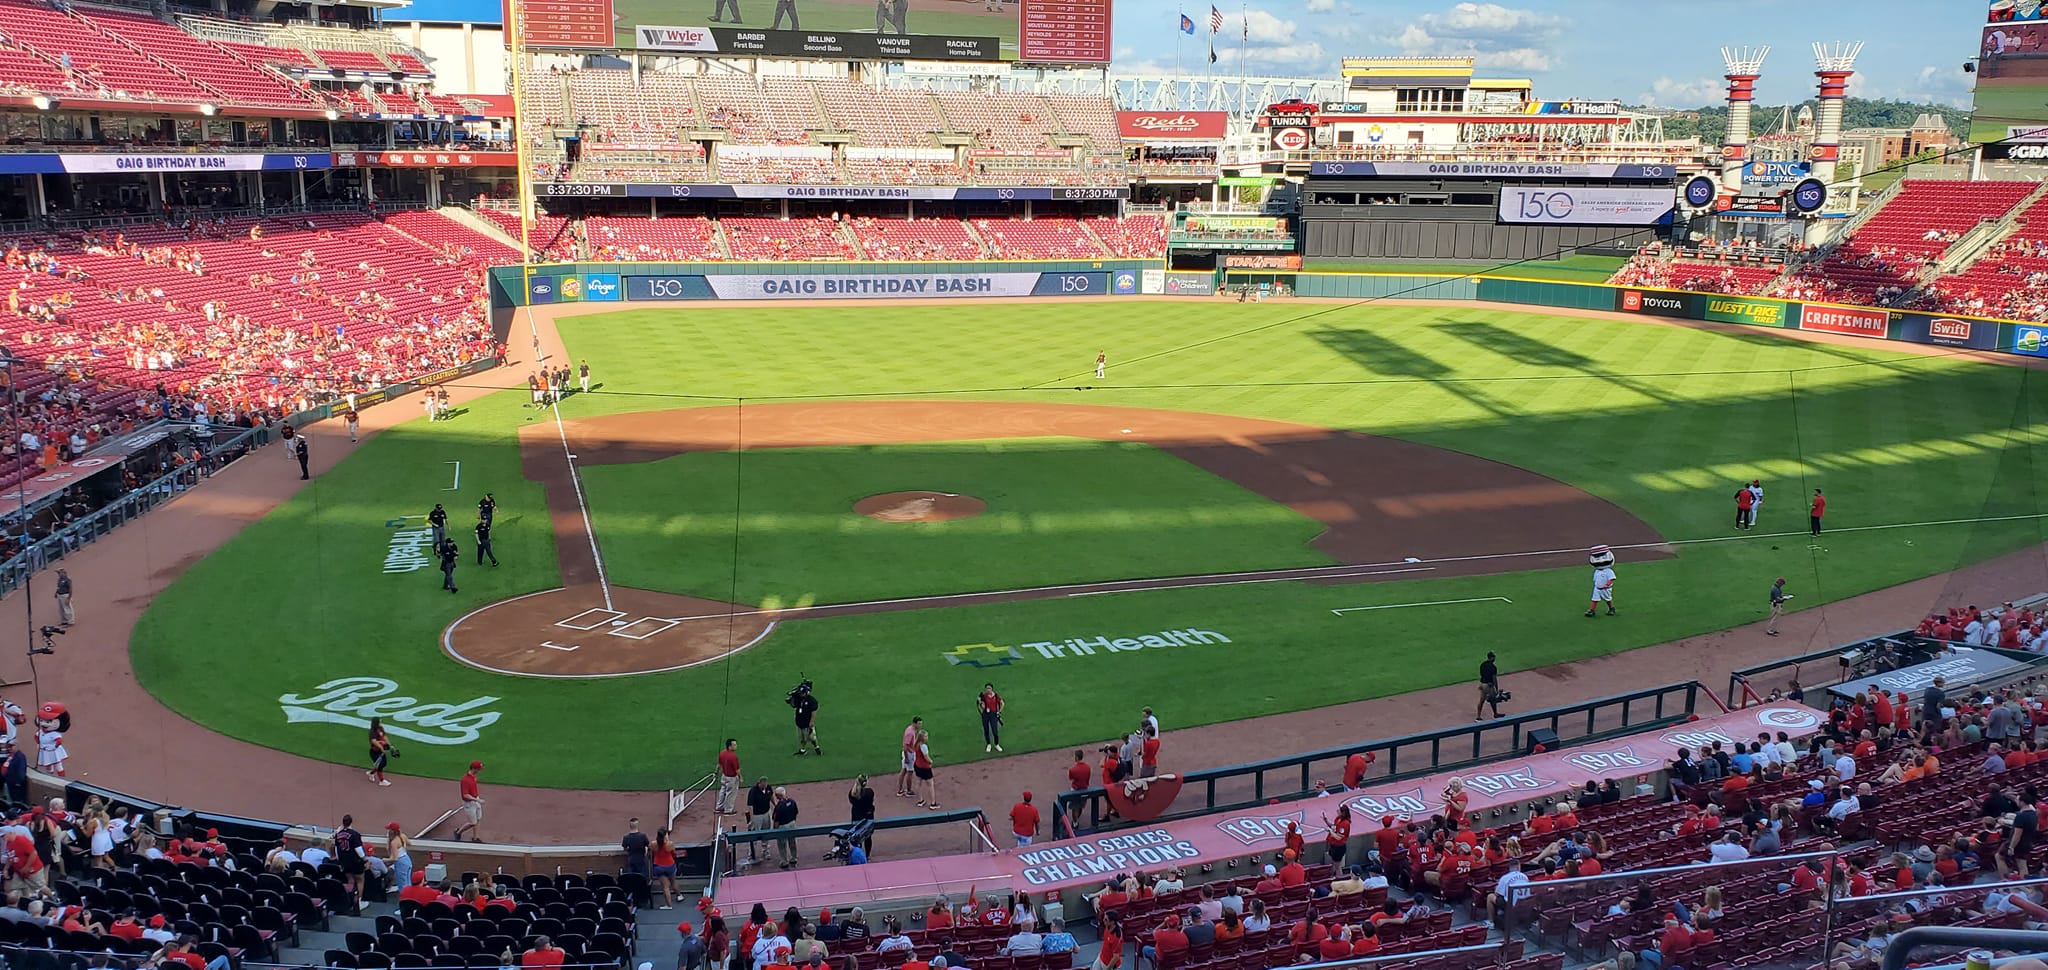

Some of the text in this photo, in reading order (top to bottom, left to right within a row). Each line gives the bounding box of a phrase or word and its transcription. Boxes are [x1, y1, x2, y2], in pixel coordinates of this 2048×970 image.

[666, 30, 704, 42] Wyler
[876, 38, 910, 46] VANOVER
[1571, 103, 1618, 114] TriHealth
[1132, 115, 1199, 128] Reds
[116, 157, 226, 168] GAIG BIRTHDAY BASH
[294, 156, 307, 167] 150
[1324, 164, 1344, 174] 150
[1429, 164, 1562, 175] GAIG BIRTHDAY BASH
[1641, 166, 1662, 177] 150
[1767, 164, 1798, 175] PNC
[547, 185, 611, 195] 6:37:30 PM
[671, 186, 690, 196] 150
[787, 188, 909, 197] GAIG BIRTHDAY BASH
[997, 189, 1014, 199] 150
[1065, 190, 1117, 198] 6:37:30 PM
[1692, 188, 1708, 197] 150
[1802, 191, 1819, 200] 150
[1517, 191, 1574, 219] 150
[589, 280, 616, 295] Kroger
[648, 280, 682, 297] 150
[763, 278, 991, 294] GAIG BIRTHDAY BASH
[1060, 276, 1088, 292] 150
[1642, 298, 1682, 309] TOYOTA
[1710, 301, 1779, 317] WEST LAKE
[1806, 312, 1882, 330] CRAFTSMAN
[1934, 323, 1965, 335] Swift
[1022, 628, 1232, 659] TriHealth
[1880, 658, 1976, 688] Reds COUNTRY
[279, 677, 503, 744] Reds
[1668, 732, 1733, 749] 1990
[1573, 750, 1642, 770] 1976
[1466, 772, 1538, 793] 1975
[1351, 796, 1426, 815] 1940
[1018, 829, 1174, 866] WORLD SERIES
[1023, 841, 1200, 884] CHAMPIONS
